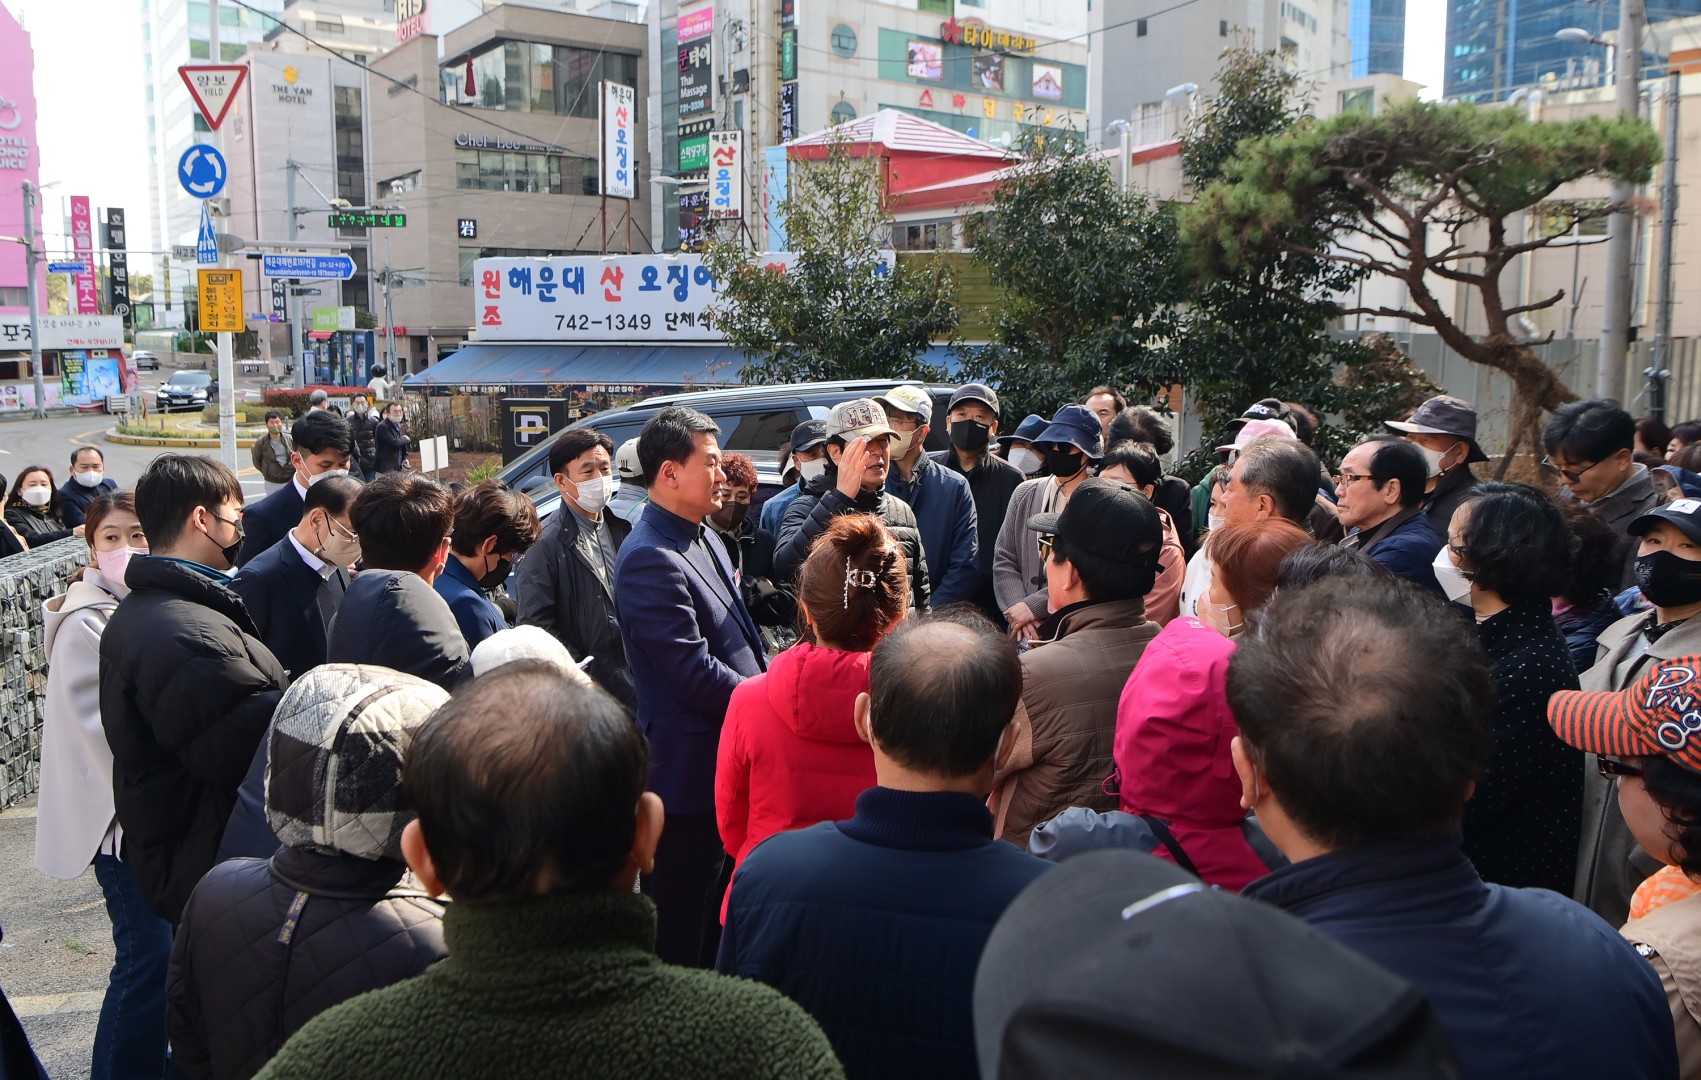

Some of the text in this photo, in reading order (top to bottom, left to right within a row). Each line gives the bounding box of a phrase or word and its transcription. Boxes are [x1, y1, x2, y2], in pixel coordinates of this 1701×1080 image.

[963, 25, 994, 49] 타이
[196, 75, 228, 87] 양보
[680, 74, 694, 87] Thai
[203, 88, 224, 97] YIELD
[272, 84, 313, 97] THE YAN
[611, 84, 632, 104] 해운대
[680, 85, 708, 99] Massage
[278, 95, 307, 105] HOTEL
[456, 131, 488, 148] Chef
[497, 135, 521, 150] Lee
[711, 133, 738, 145] 해운대
[460, 219, 475, 237] 岩
[198, 252, 217, 263] 횡단보도
[508, 266, 585, 303] 해운대
[600, 265, 624, 303] 산
[638, 264, 717, 303] 오징어
[555, 314, 652, 332] 742-1349
[521, 415, 543, 443] P
